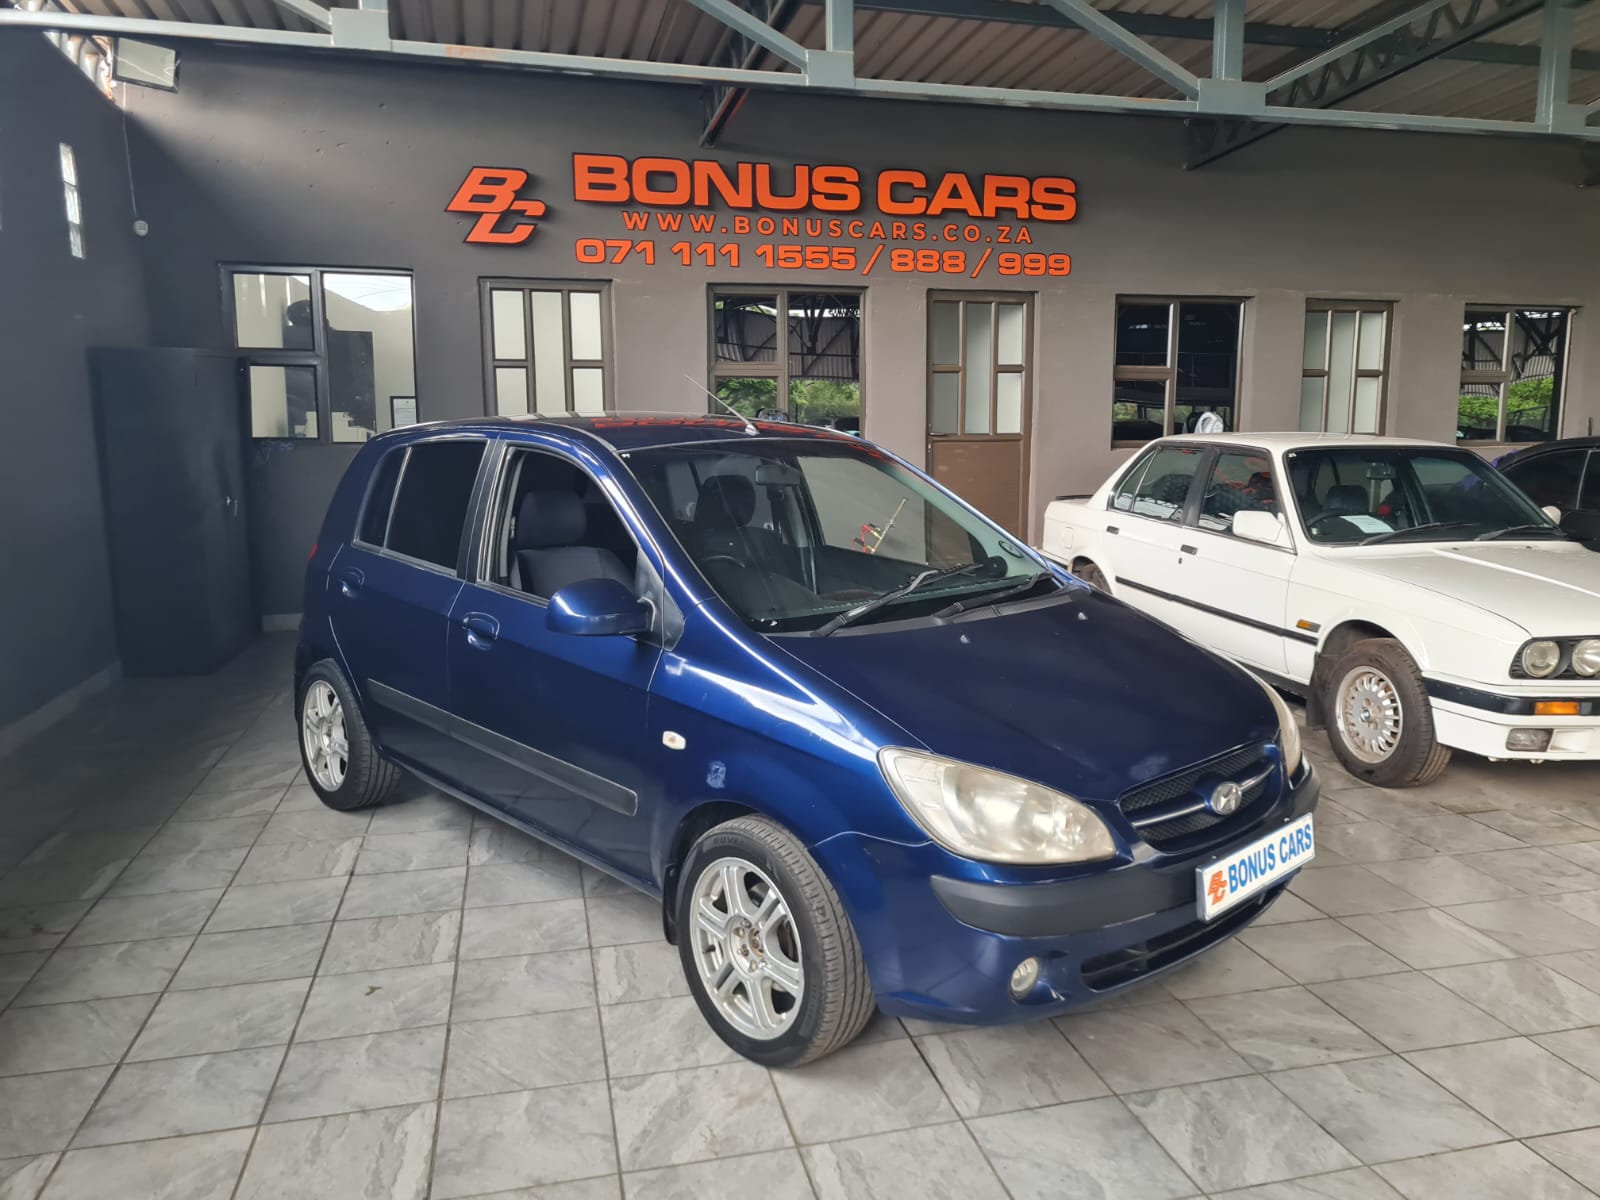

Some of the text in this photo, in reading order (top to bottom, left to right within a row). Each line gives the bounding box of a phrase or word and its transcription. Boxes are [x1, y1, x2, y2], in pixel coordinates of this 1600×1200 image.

[573, 153, 1077, 222] BONUS CARS
[575, 238, 655, 265] 071
[671, 241, 739, 267] 111
[622, 210, 1032, 244] WWW.BONUSCARS.CO.ZA
[1228, 843, 1276, 893] BONUS
[1279, 823, 1312, 863] CARS
